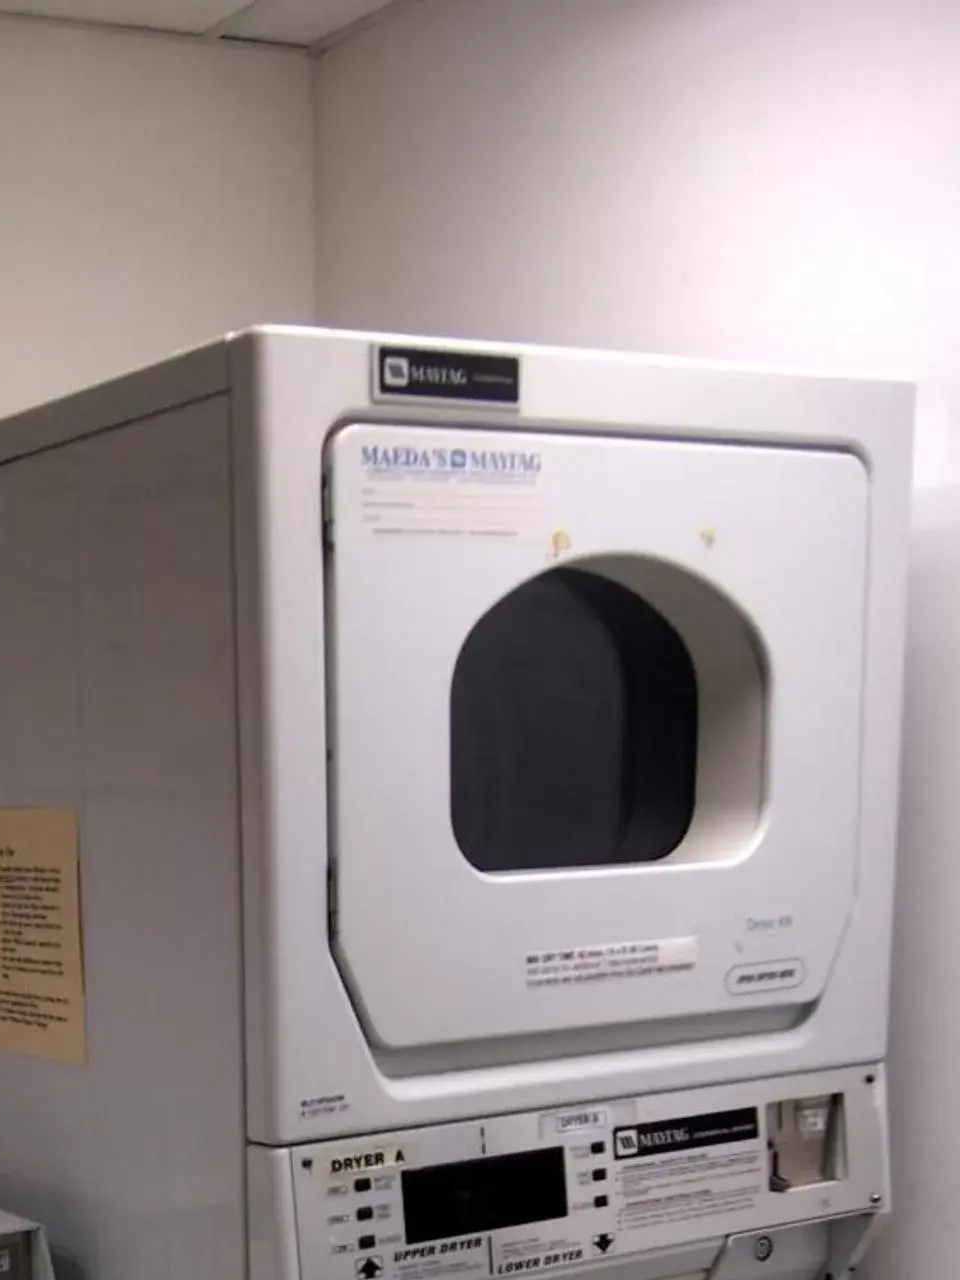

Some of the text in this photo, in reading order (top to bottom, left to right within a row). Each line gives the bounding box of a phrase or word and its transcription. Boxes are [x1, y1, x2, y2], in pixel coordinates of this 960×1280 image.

[638, 1127, 690, 1147] MAYTAG
[330, 1148, 405, 1174] DRYER A
[393, 1245, 436, 1263] UPPER
[440, 1236, 483, 1255] DRYER
[497, 1248, 584, 1275] LOWER DRYER
